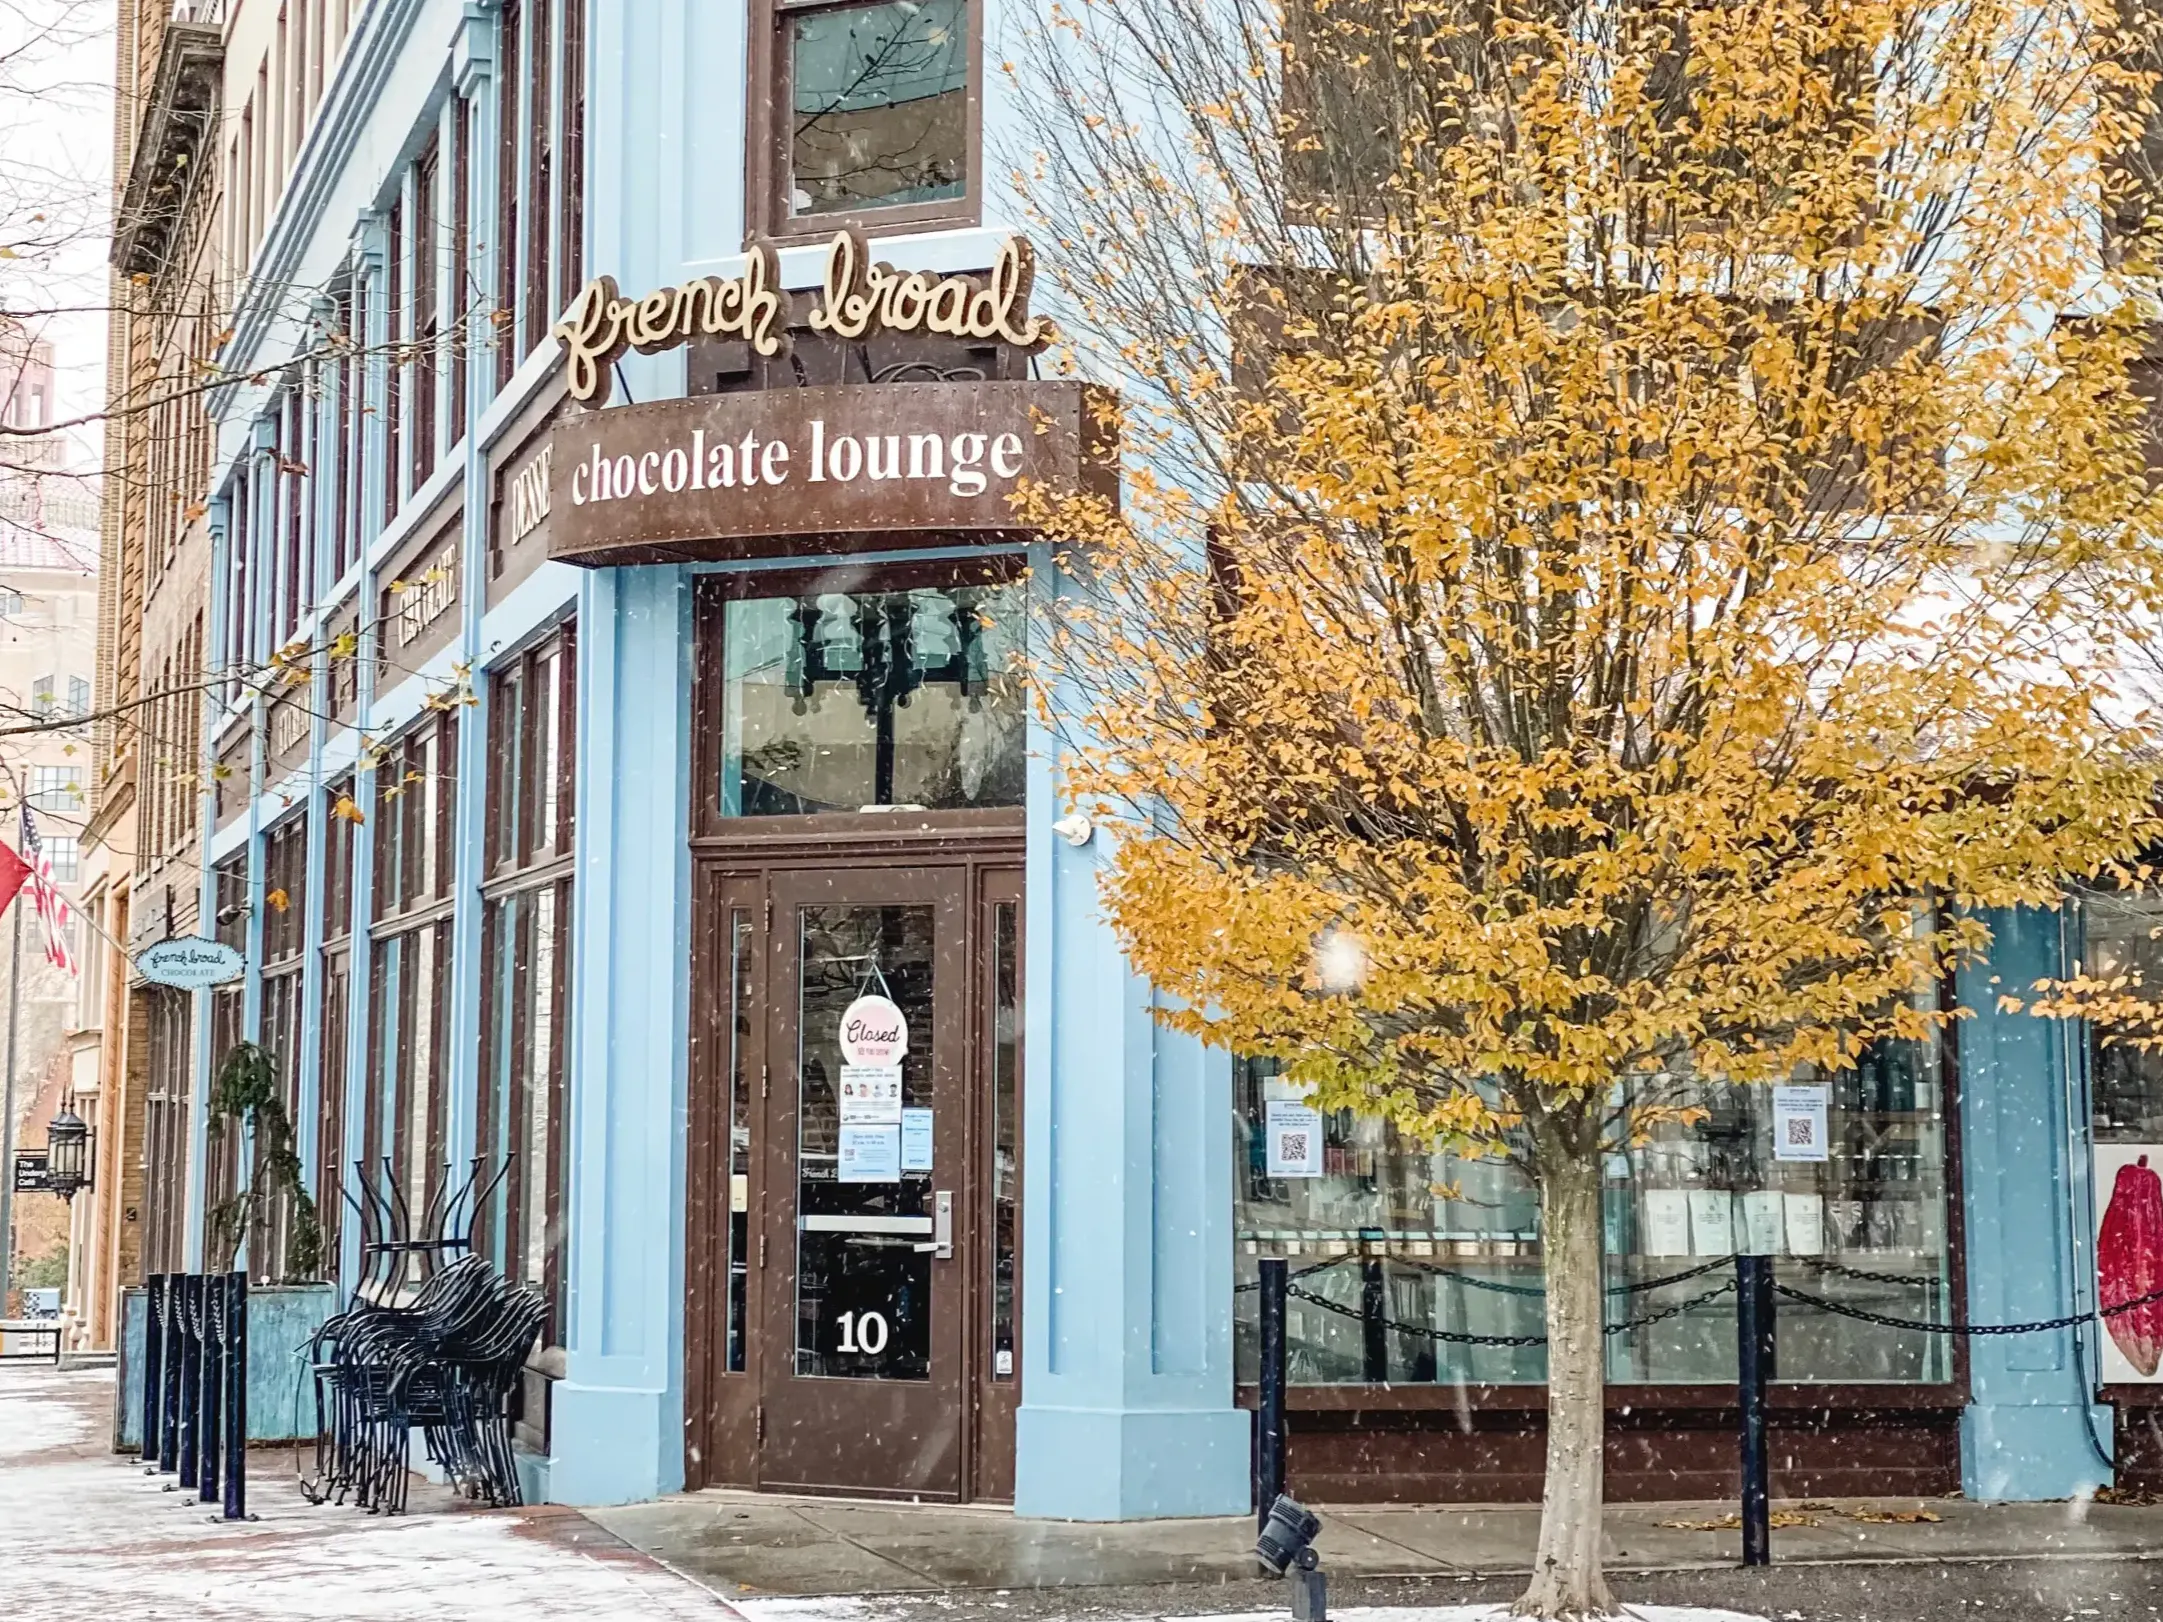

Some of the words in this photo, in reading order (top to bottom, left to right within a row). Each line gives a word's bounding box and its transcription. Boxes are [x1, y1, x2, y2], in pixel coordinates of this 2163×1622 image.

[553, 245, 779, 401] french
[808, 229, 1041, 347] broad
[571, 428, 790, 506] chocolate
[807, 420, 1024, 498] lounge
[511, 442, 554, 546] DESSE
[150, 950, 188, 969] french
[188, 949, 226, 965] broad
[161, 968, 215, 978] CHOCOLATE
[846, 1019, 900, 1043] Closed
[18, 1160, 34, 1168] The
[18, 1169, 48, 1179] Underg
[837, 1310, 888, 1355] 10
